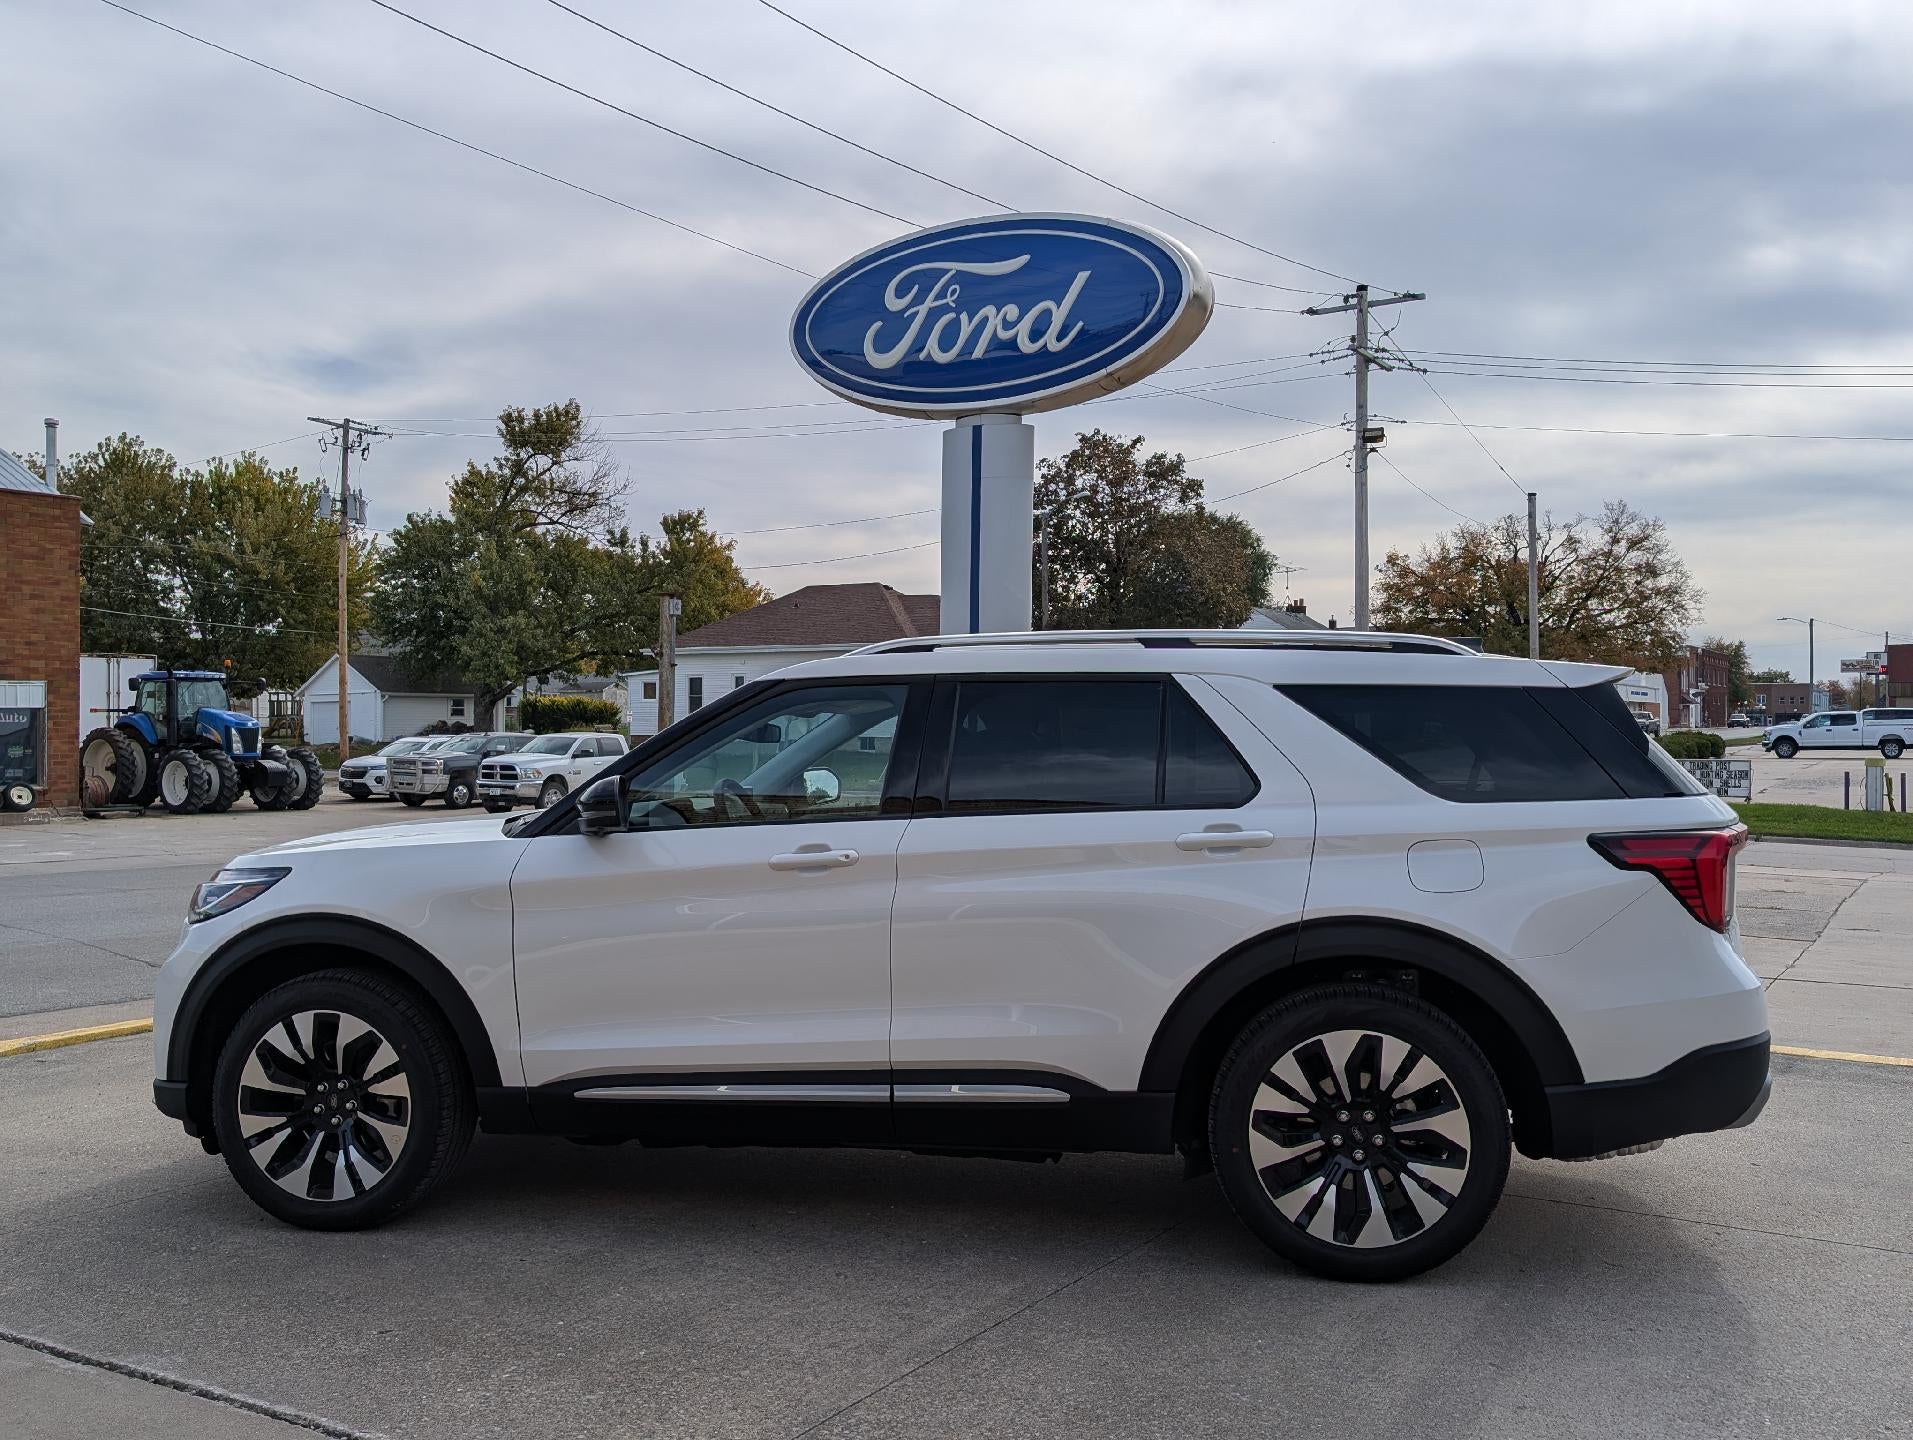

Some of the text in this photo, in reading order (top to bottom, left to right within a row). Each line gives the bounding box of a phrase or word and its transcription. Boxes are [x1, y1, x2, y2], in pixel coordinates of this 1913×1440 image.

[864, 254, 1091, 369] Ford
[1689, 761, 1713, 770] TRADING
[1715, 761, 1731, 770] POST
[1700, 770, 1724, 779] HUNTING
[1725, 770, 1749, 779] SEASON
[1719, 778, 1742, 788] SHELLS
